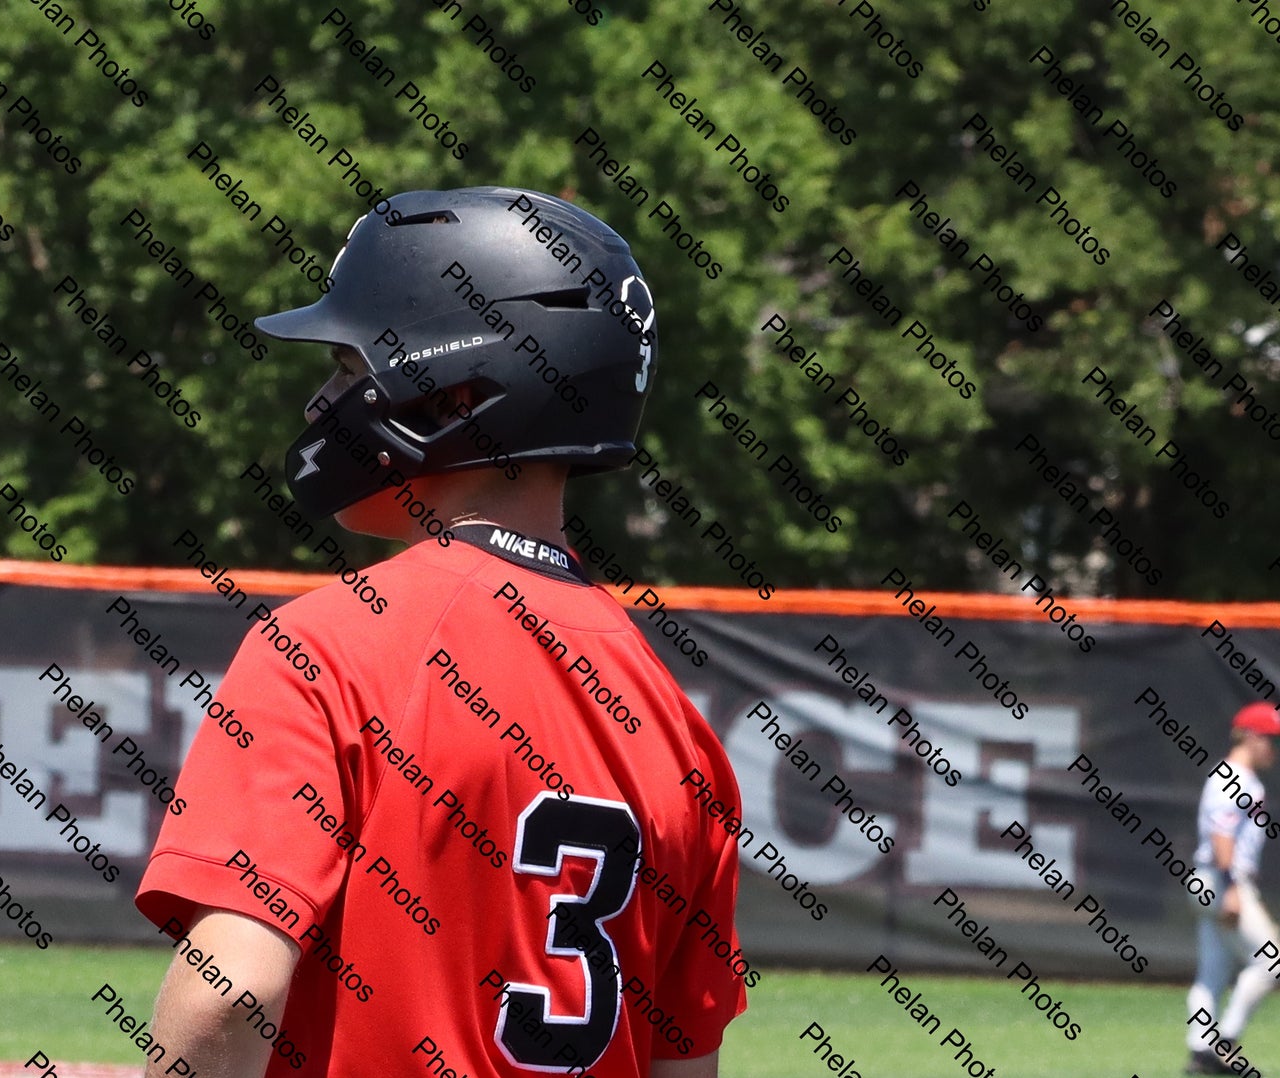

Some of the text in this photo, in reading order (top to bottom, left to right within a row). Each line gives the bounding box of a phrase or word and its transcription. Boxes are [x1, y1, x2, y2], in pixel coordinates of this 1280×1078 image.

[488, 529, 569, 569] NIKE PRO
[494, 790, 642, 1074] 3
